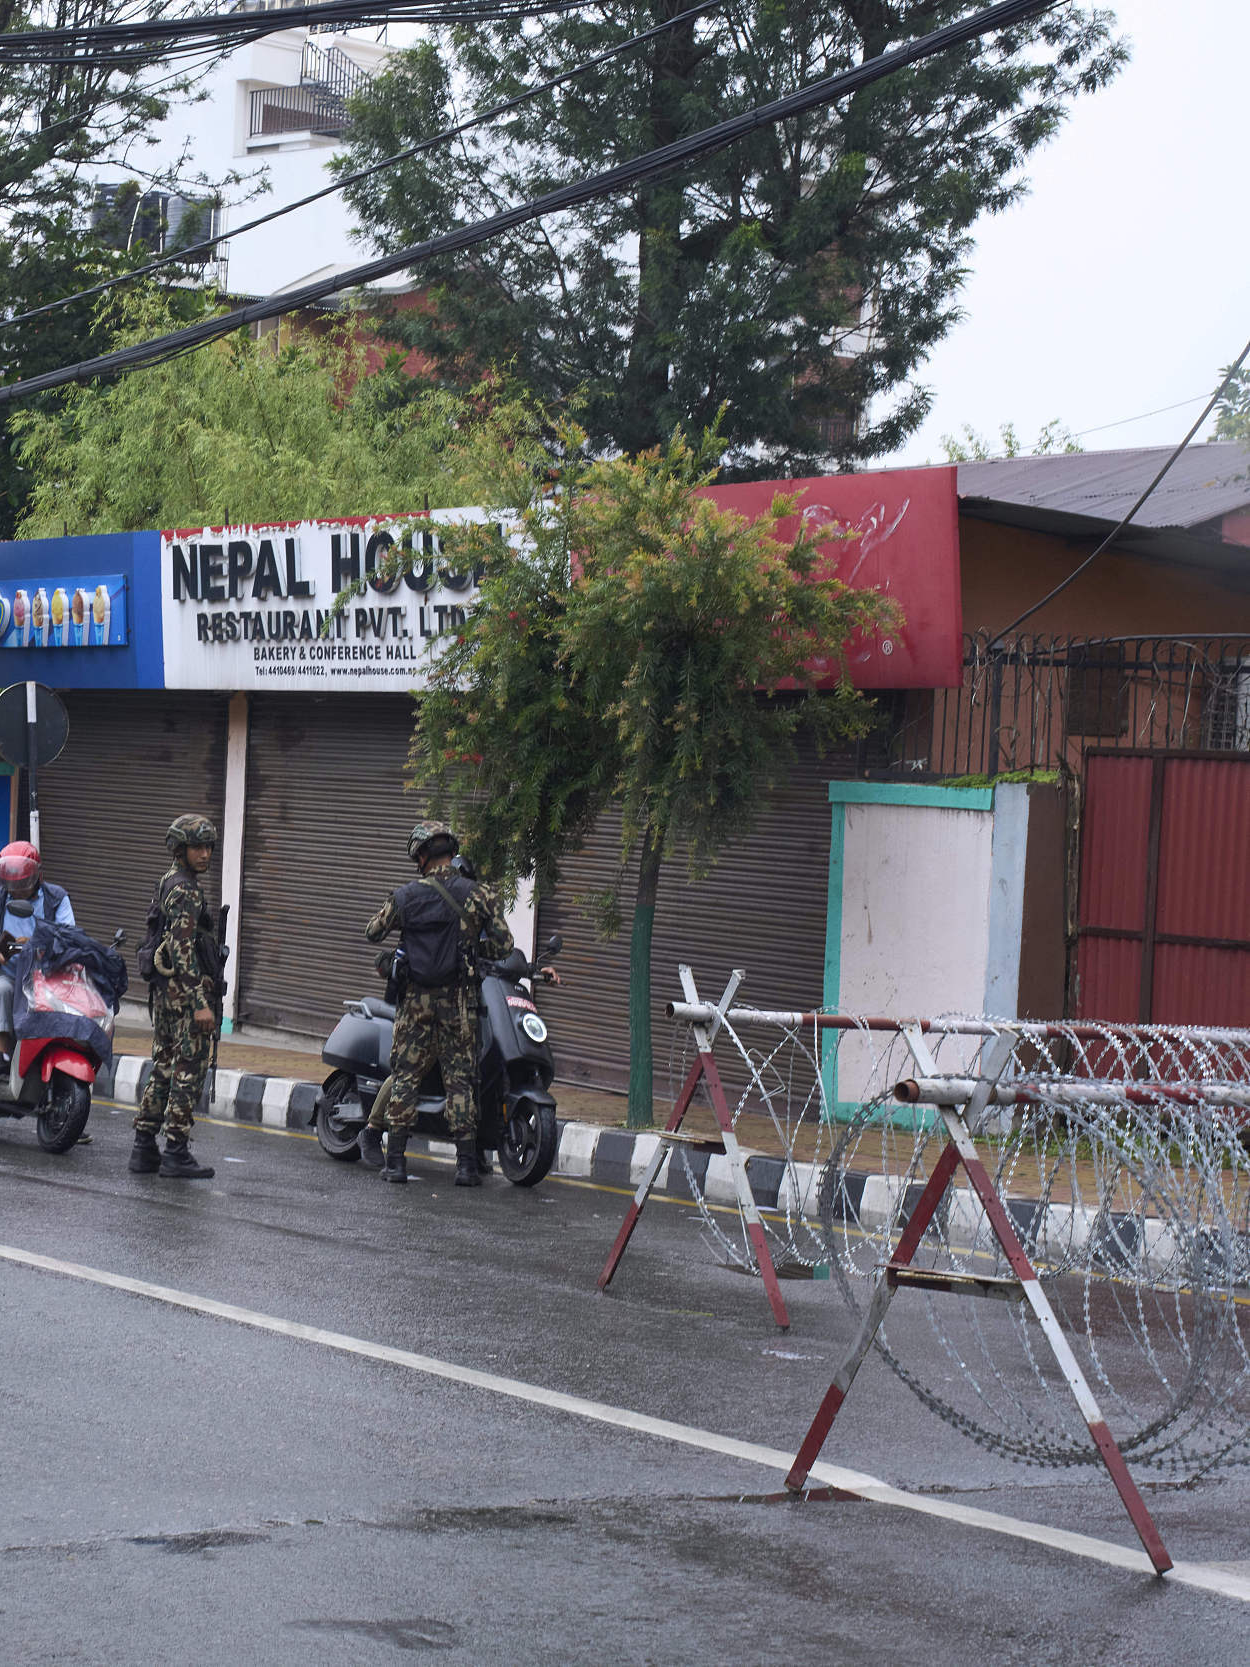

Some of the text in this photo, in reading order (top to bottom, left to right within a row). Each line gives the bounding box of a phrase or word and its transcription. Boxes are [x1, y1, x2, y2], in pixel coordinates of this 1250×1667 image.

[172, 537, 314, 601] NEPAL
[196, 608, 348, 642] RESTAURANT
[355, 606, 410, 639] PVT.
[253, 644, 417, 661] BAKERY & CONFERENCE HALL
